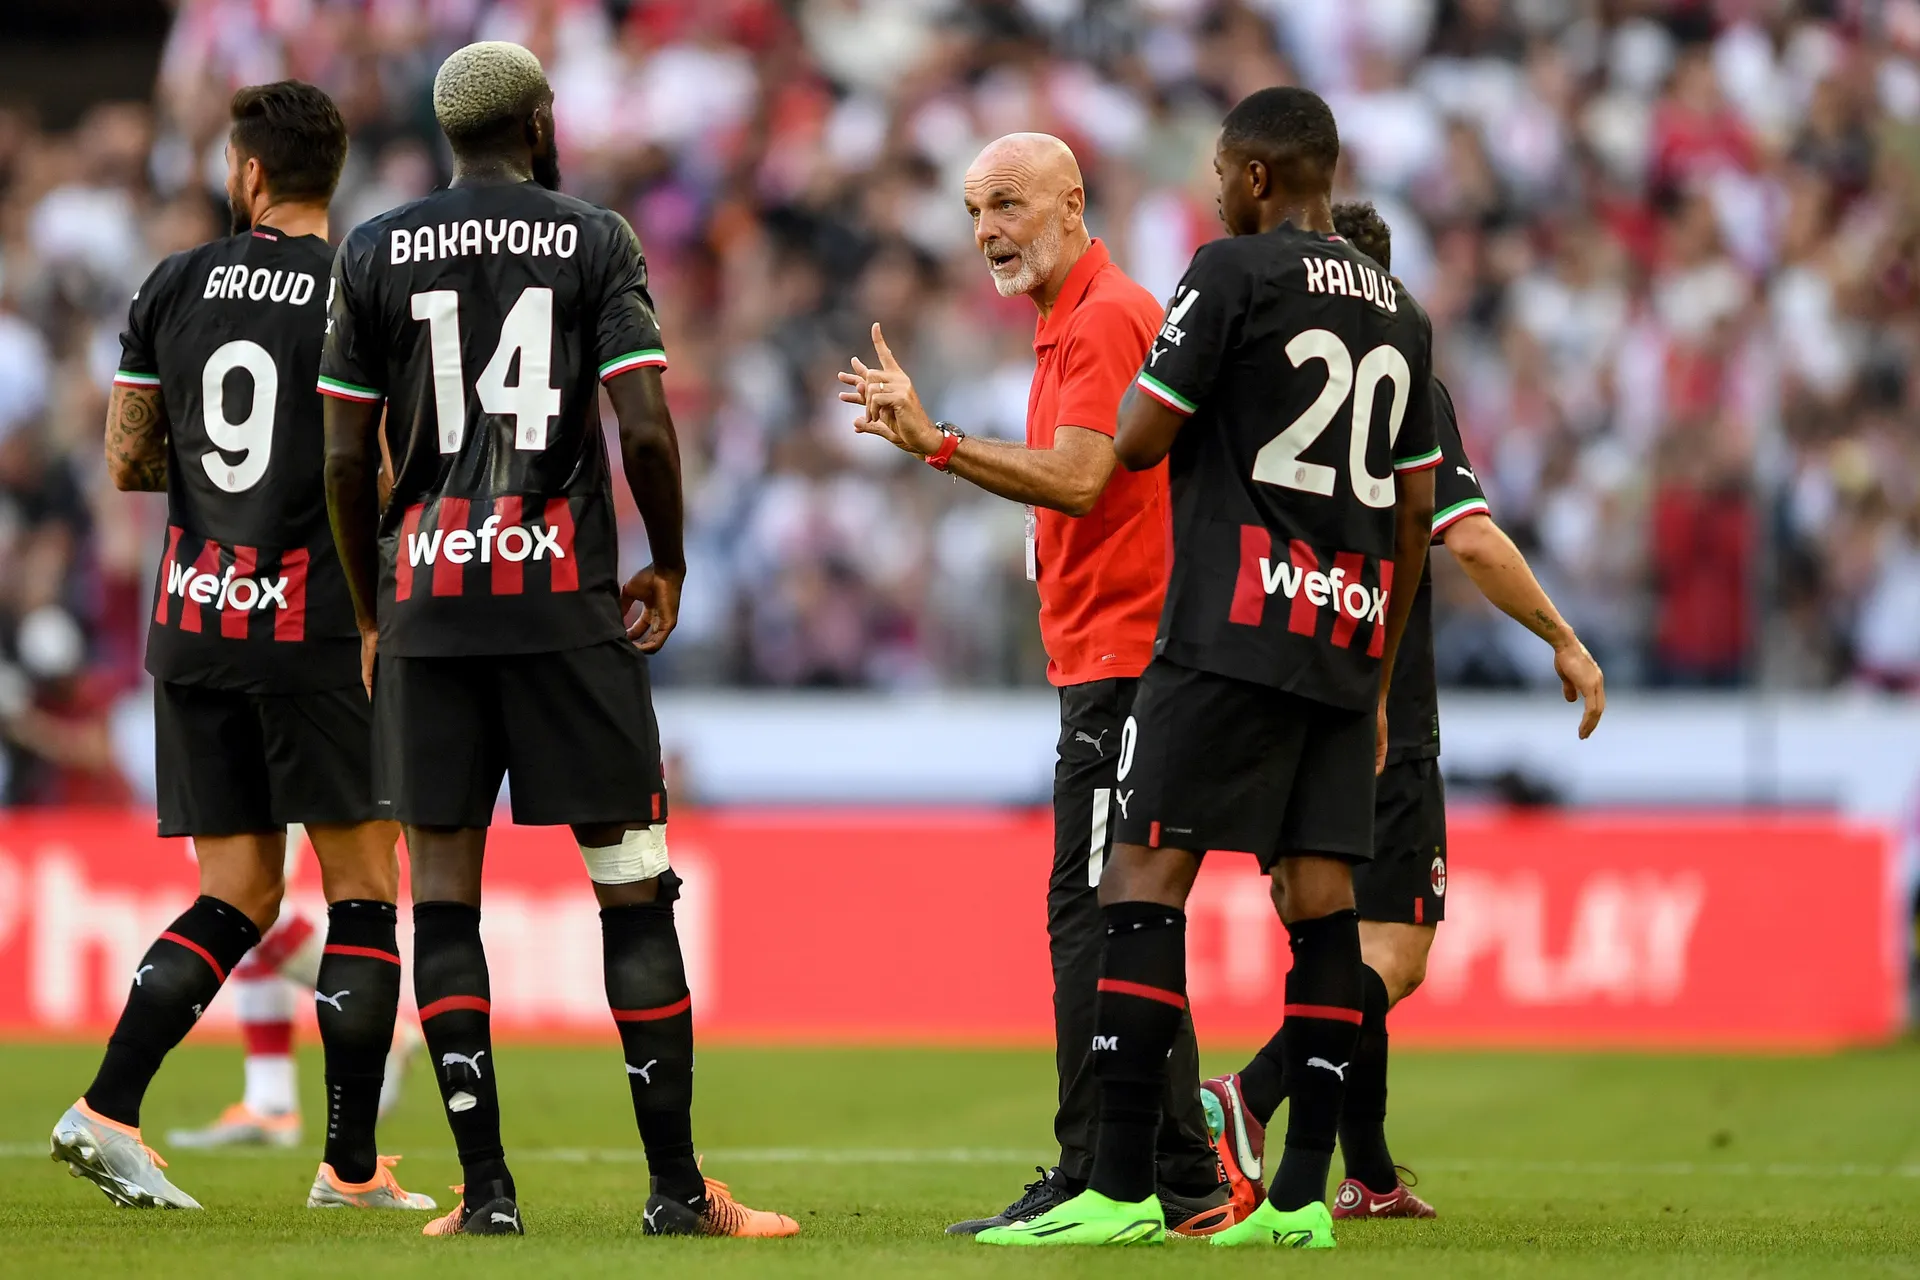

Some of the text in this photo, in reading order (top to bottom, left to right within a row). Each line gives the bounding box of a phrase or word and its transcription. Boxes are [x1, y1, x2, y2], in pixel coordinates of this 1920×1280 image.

[390, 219, 578, 265] BAKAYOKO
[202, 264, 315, 306] GIROUD
[1302, 257, 1397, 313] KALULU
[410, 287, 562, 454] 14
[201, 339, 279, 493] 9
[1251, 328, 1412, 508] 20
[407, 514, 565, 568] wefox
[166, 559, 288, 610] wefox
[1258, 557, 1388, 626] wefox
[1428, 868, 1706, 1006] PLAY
